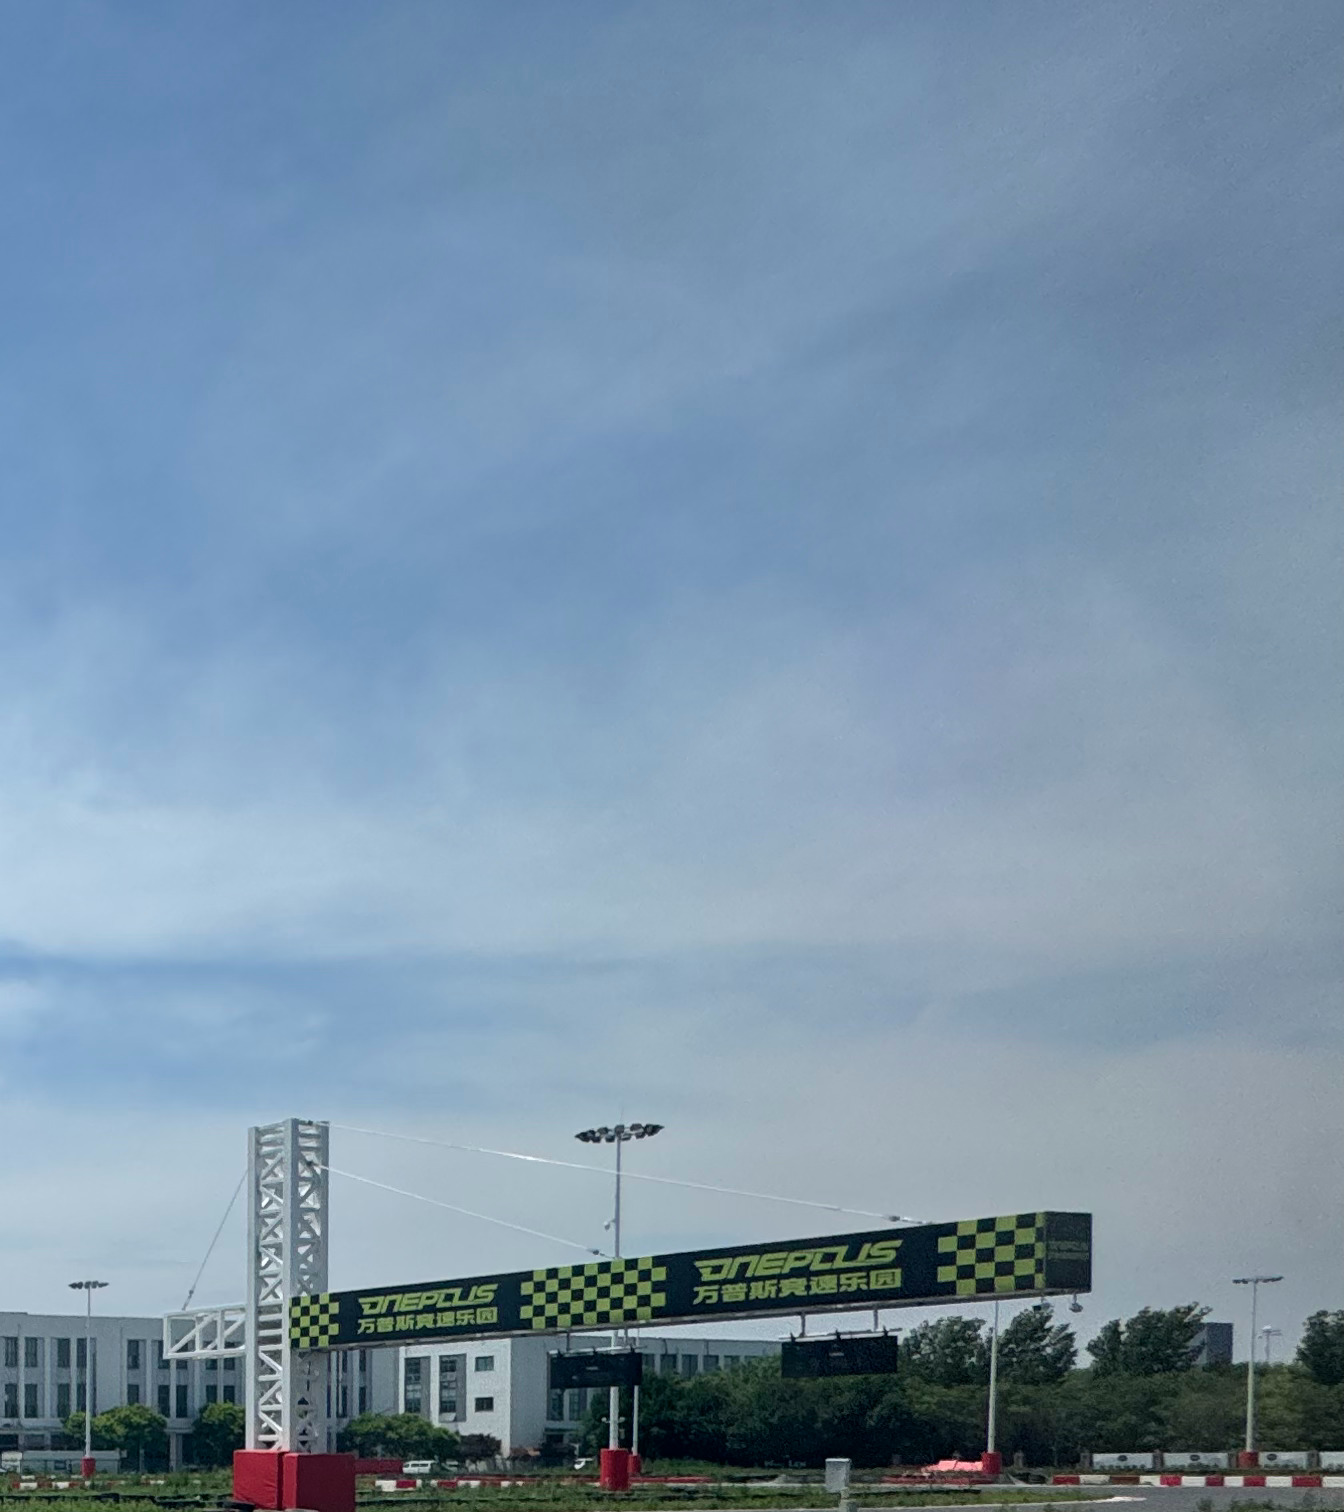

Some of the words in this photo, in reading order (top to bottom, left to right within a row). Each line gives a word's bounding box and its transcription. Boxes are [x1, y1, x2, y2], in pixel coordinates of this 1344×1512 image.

[693, 1239, 903, 1282] ONEPLUS
[358, 1283, 499, 1316] ONEPLUS
[693, 1268, 902, 1305] 万普斯竞速乐园
[357, 1306, 499, 1335] 万普斯竞速乐园
